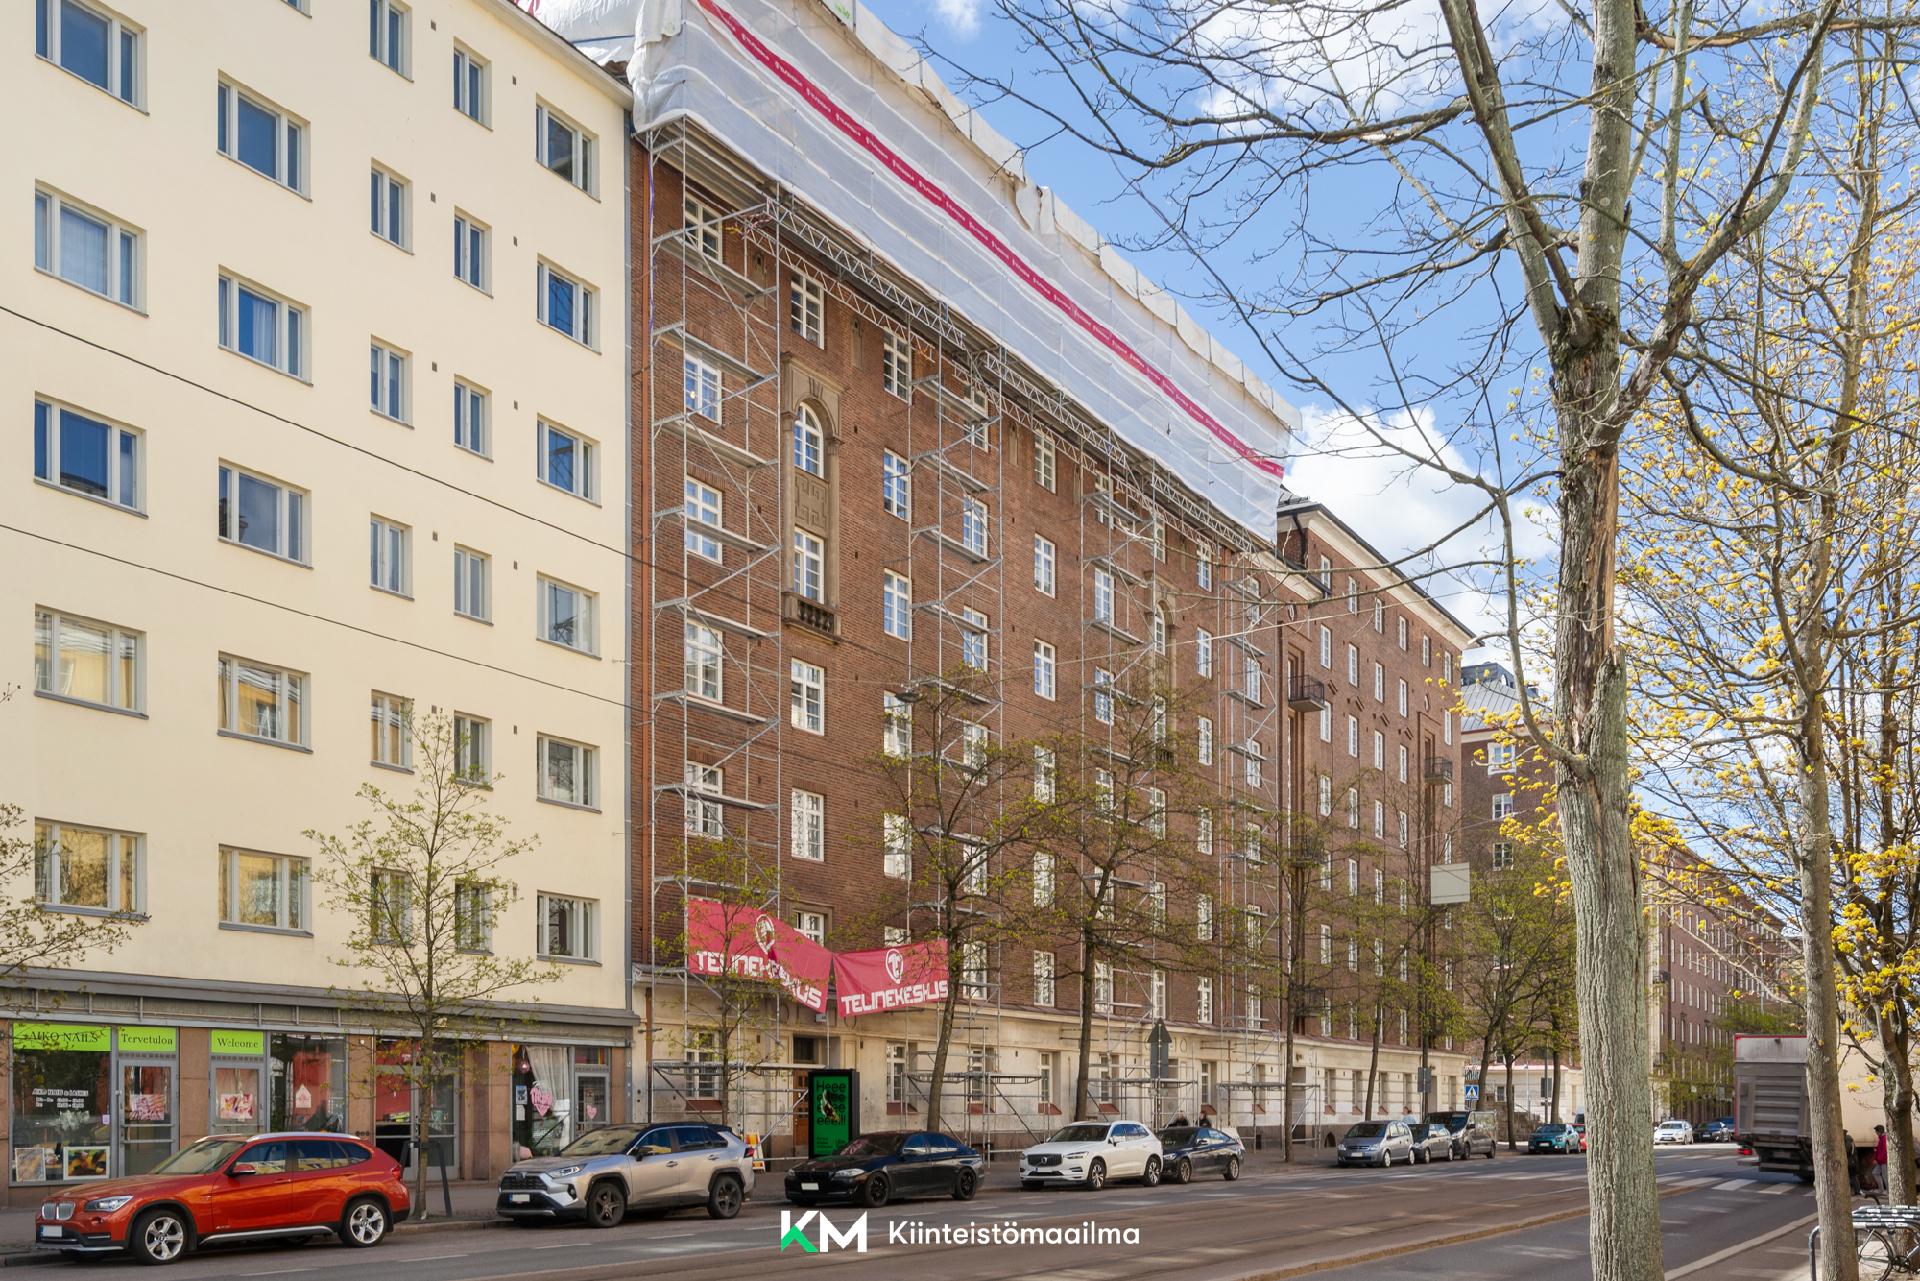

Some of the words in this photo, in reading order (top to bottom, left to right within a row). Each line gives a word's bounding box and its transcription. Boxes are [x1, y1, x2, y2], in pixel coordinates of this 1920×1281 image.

[841, 980, 949, 1015] TELINEKESKUS
[63, 1031, 99, 1043] NAILS
[121, 1033, 173, 1045] Tervetuloa
[217, 1037, 259, 1049] Welcome
